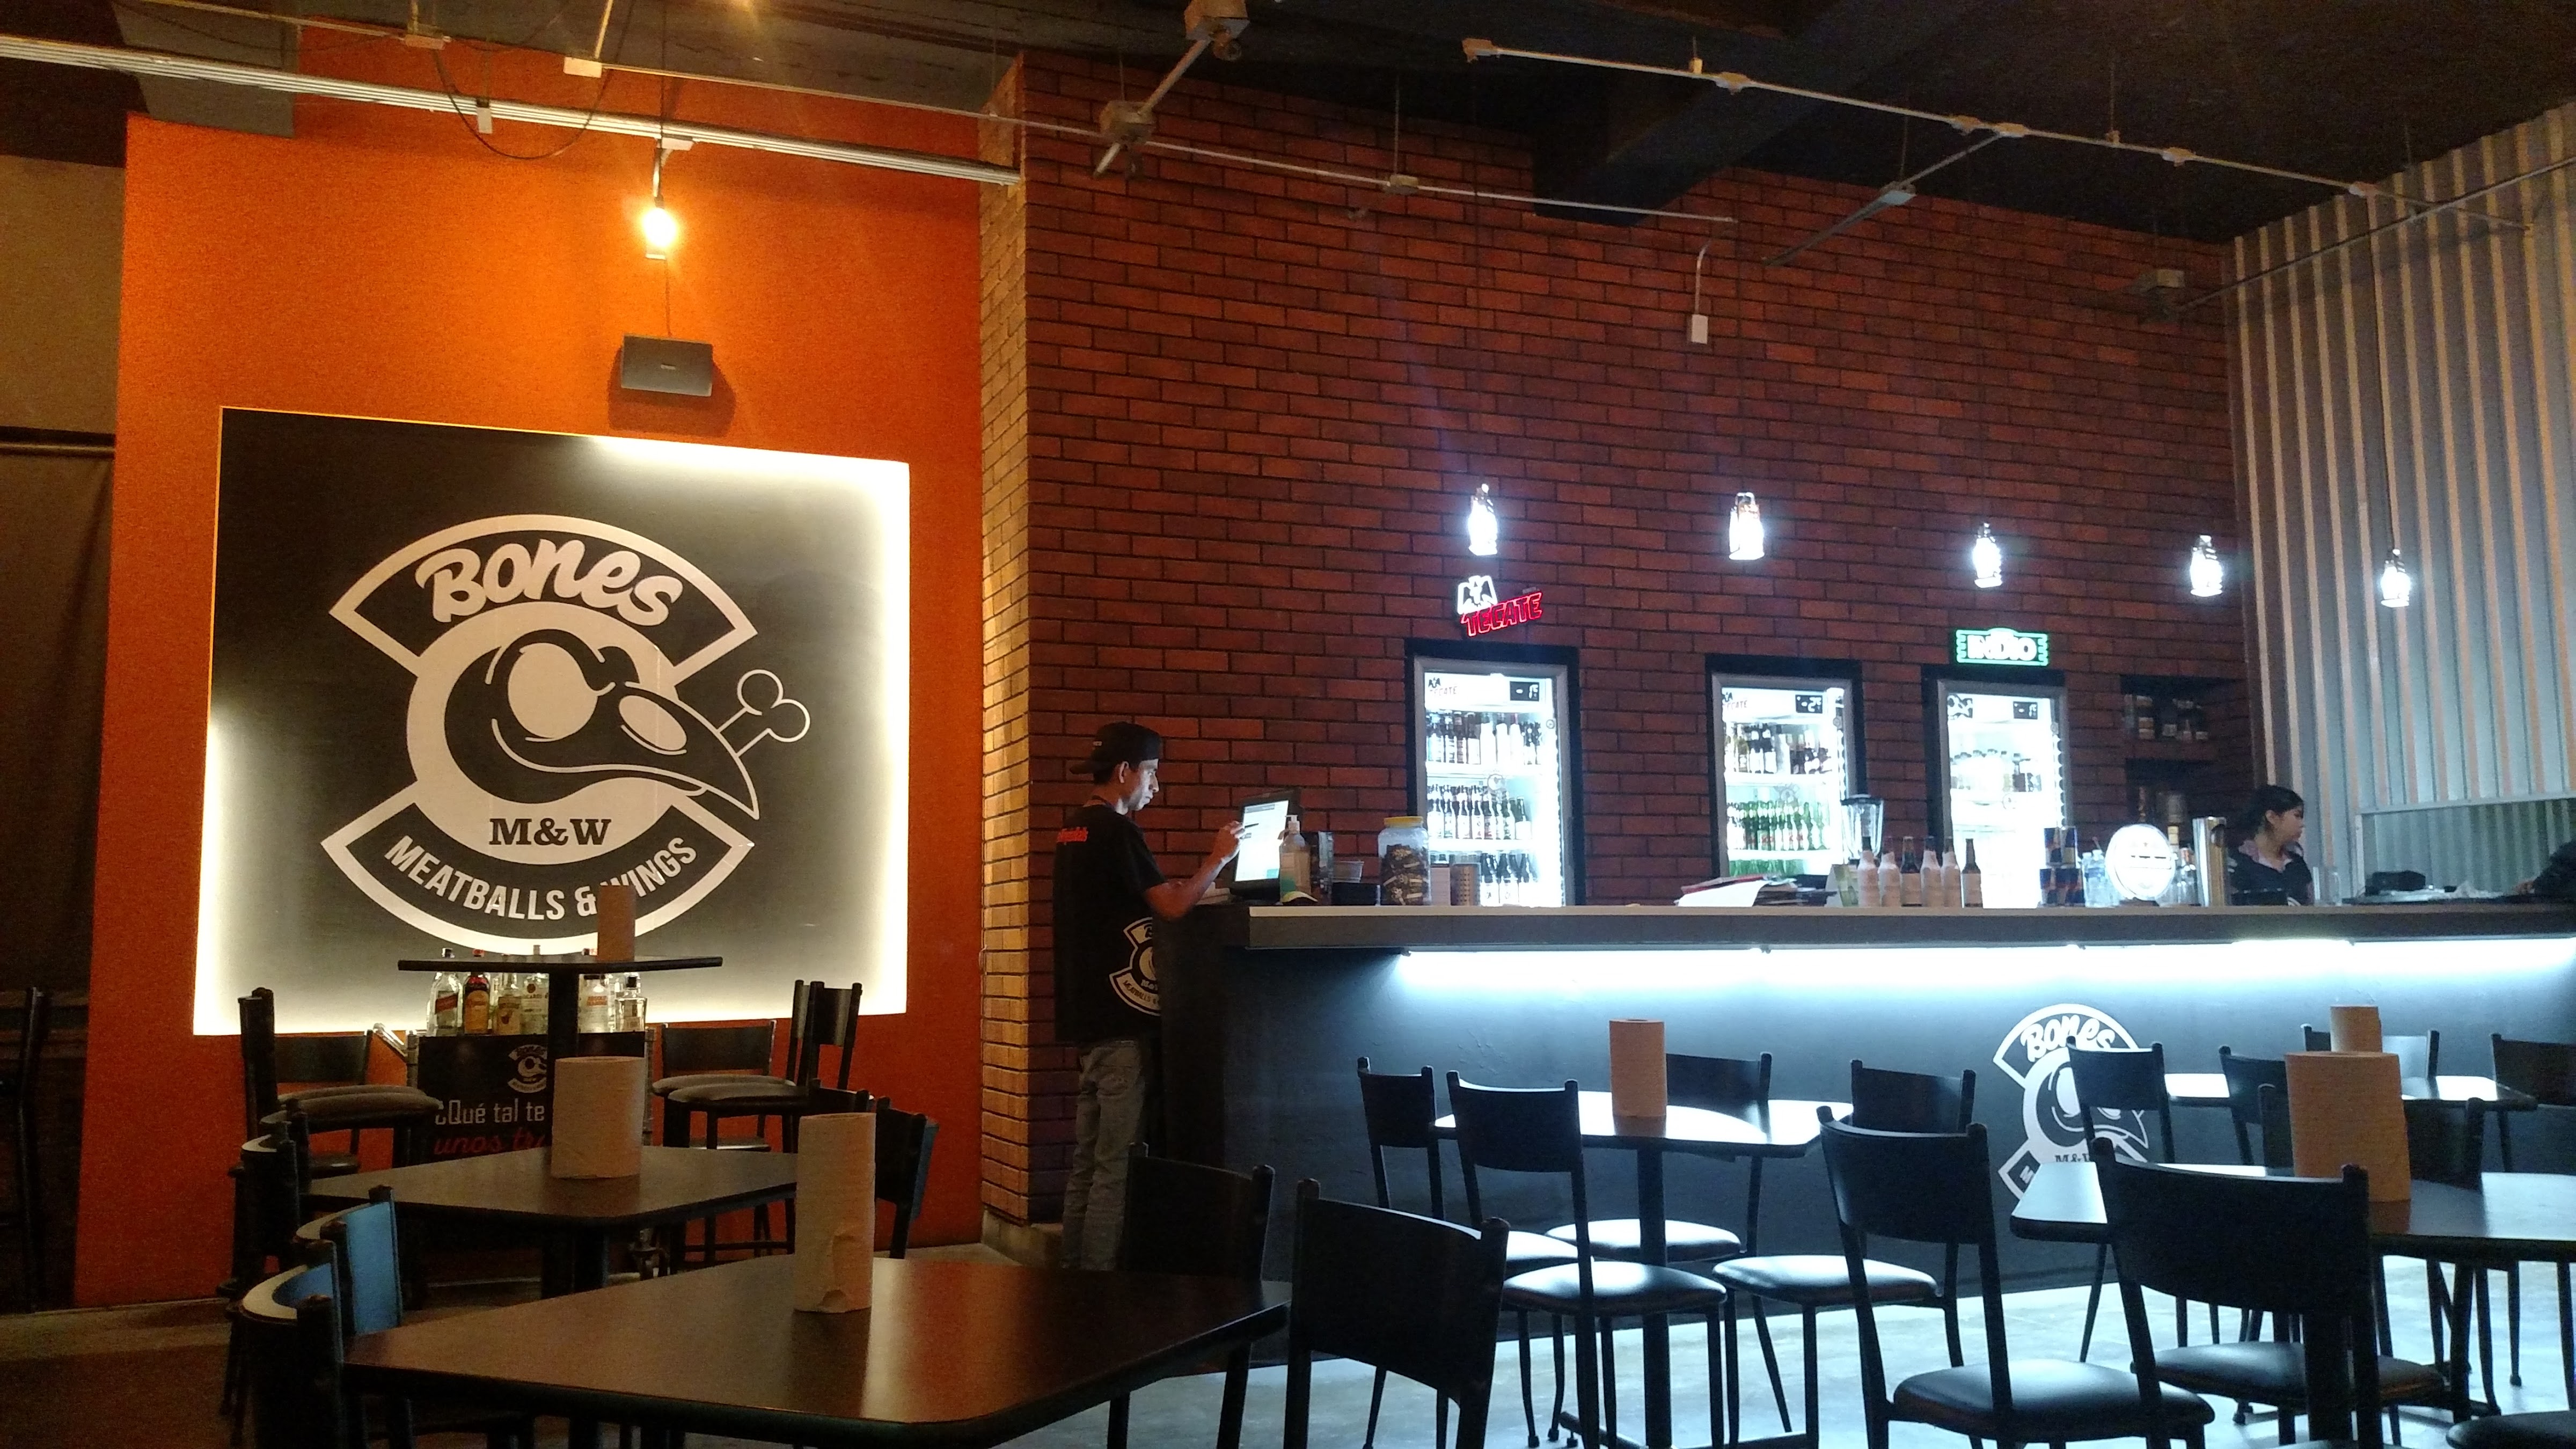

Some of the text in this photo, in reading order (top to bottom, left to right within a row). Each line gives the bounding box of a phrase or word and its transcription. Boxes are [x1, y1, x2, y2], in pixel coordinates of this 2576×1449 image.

[414, 538, 683, 626] Bones
[1461, 591, 1542, 636] TECATE
[489, 818, 612, 846] M&W
[384, 835, 565, 920] MEATBALLS
[576, 885, 596, 917] &
[2020, 1014, 2116, 1063] Bones
[435, 1098, 545, 1125] ¿Qué tal te
[435, 1135, 502, 1154] unos
